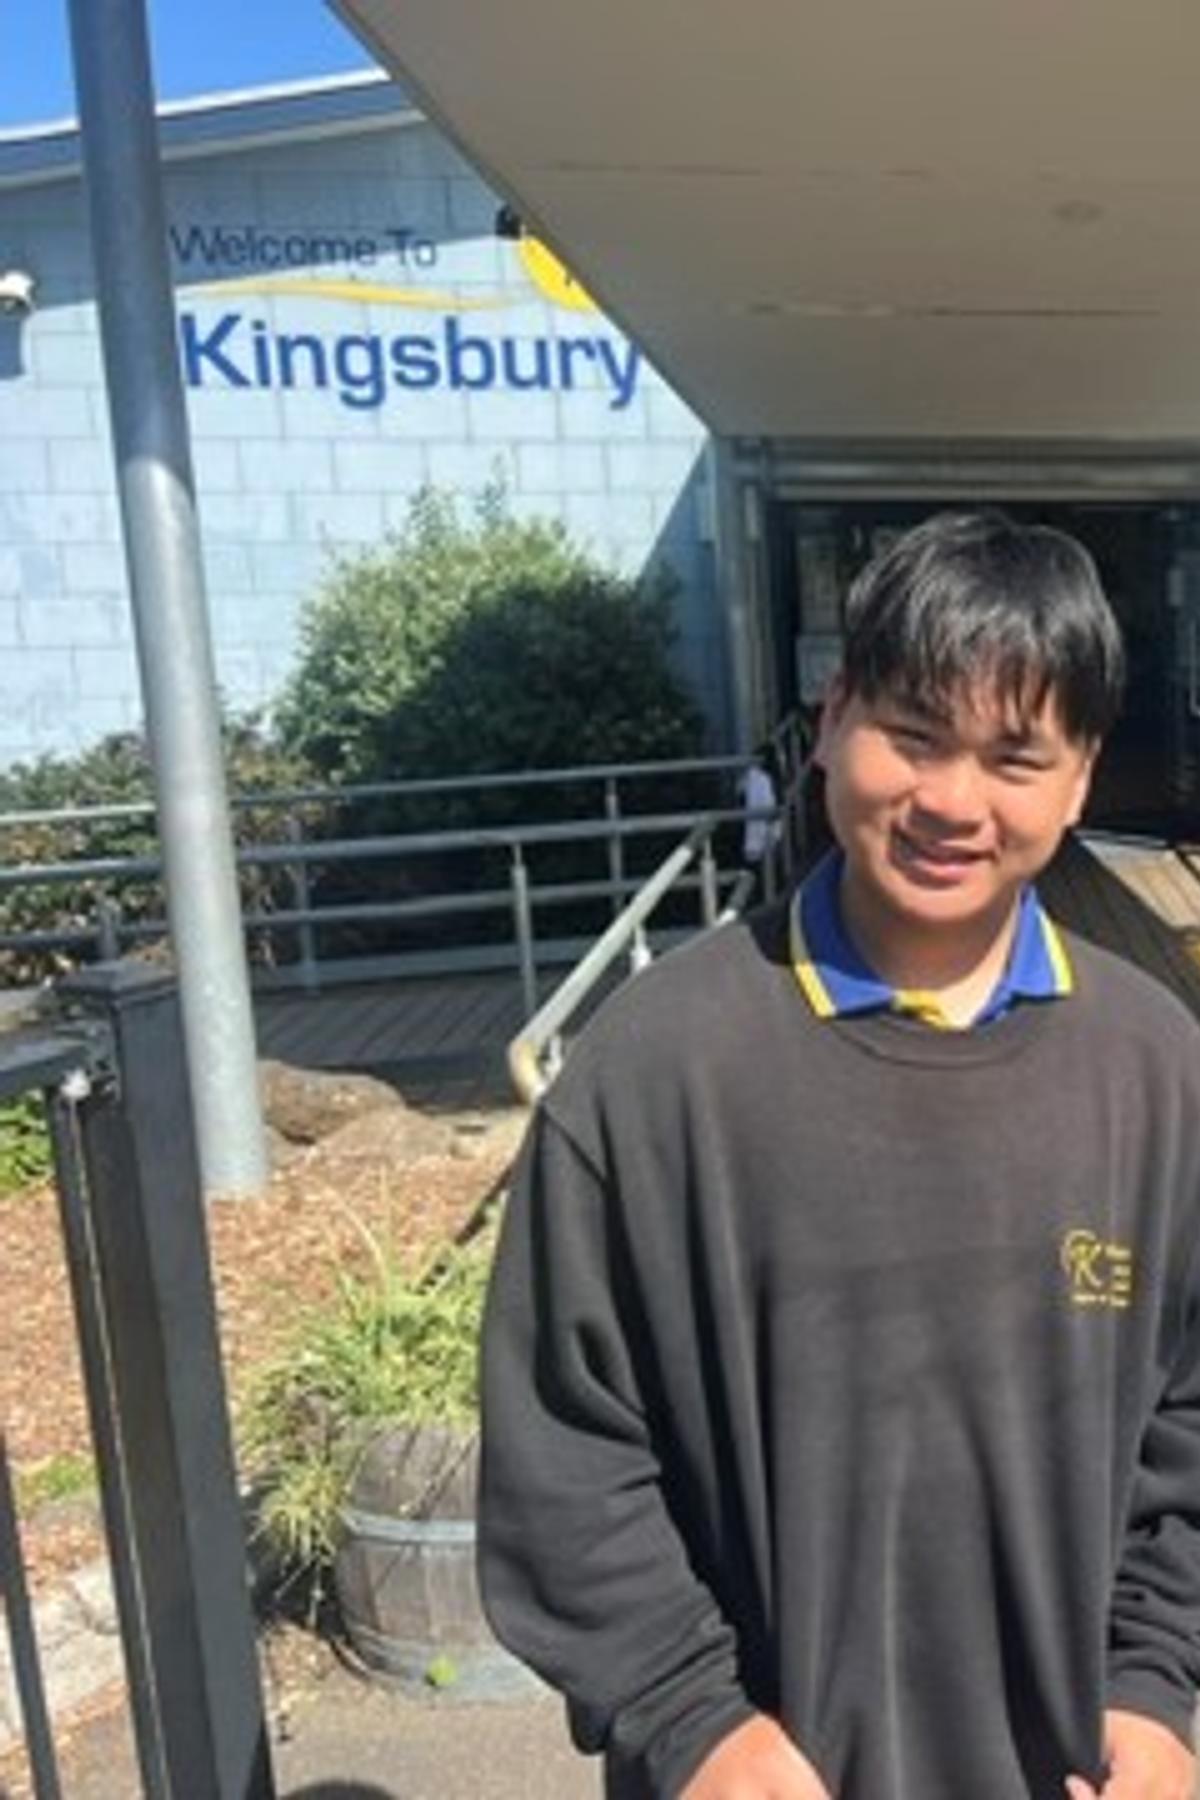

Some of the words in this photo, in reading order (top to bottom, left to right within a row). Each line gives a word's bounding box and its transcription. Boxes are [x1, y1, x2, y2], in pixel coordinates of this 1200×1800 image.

[170, 225, 377, 266] Welcome
[392, 226, 438, 267] To
[180, 314, 644, 409] Kingsbury
